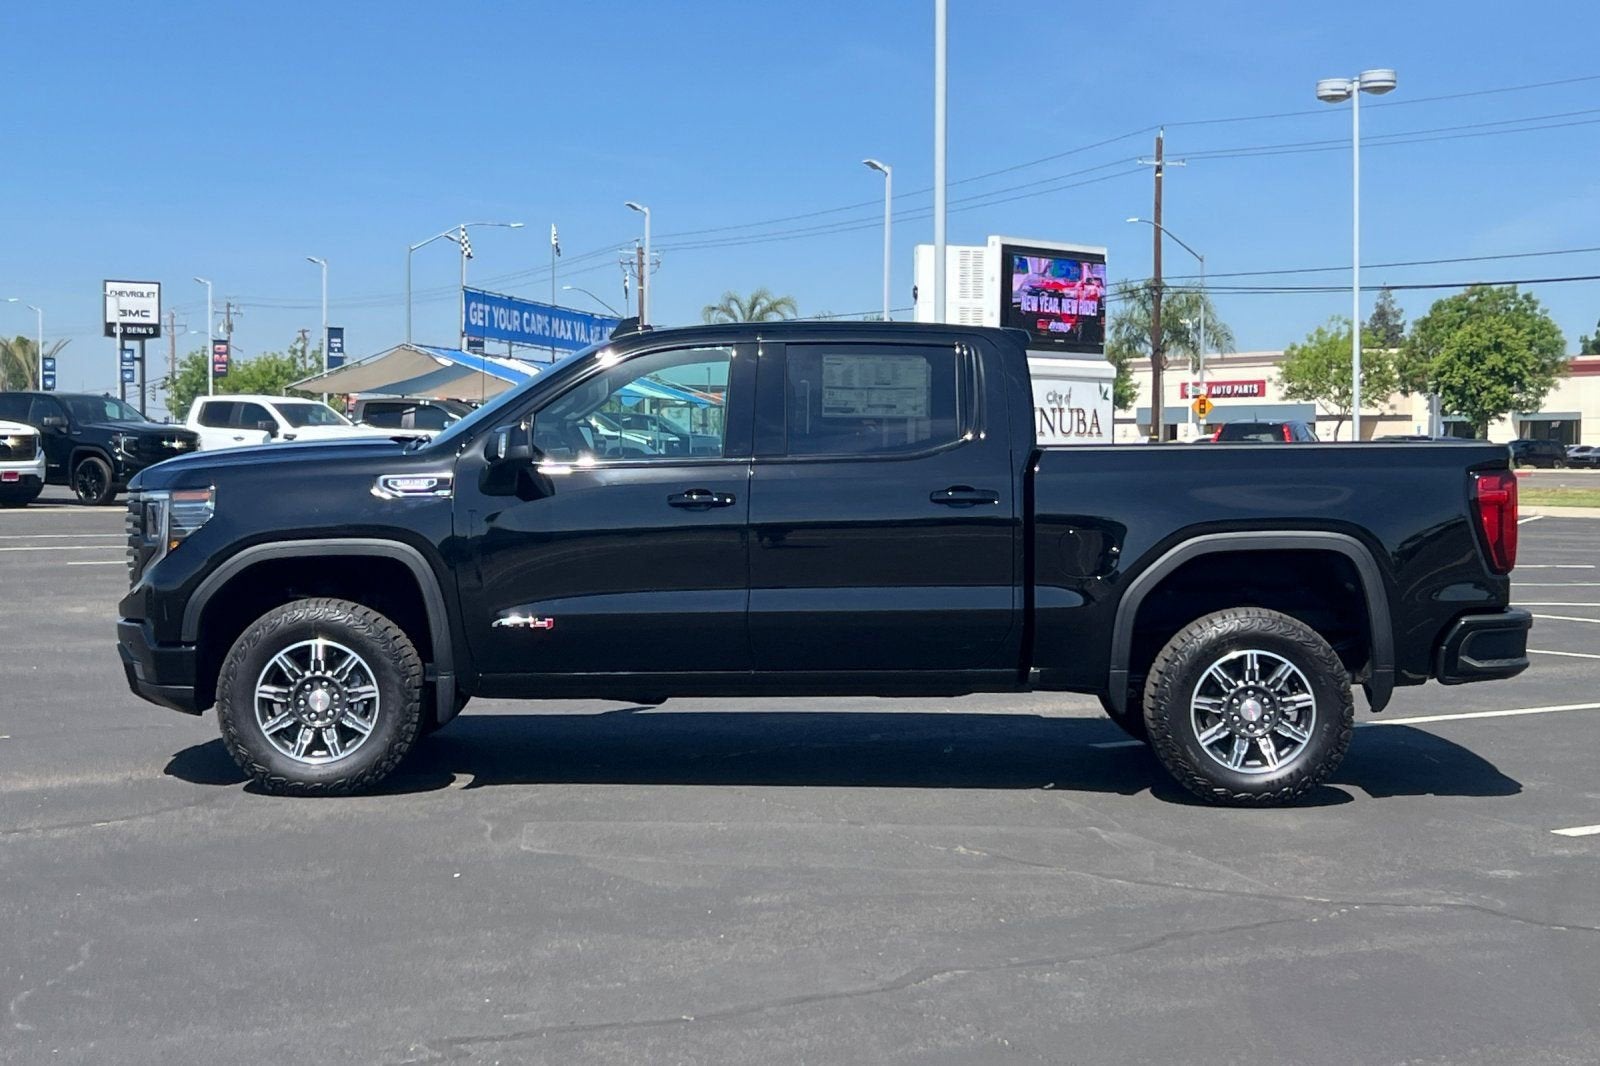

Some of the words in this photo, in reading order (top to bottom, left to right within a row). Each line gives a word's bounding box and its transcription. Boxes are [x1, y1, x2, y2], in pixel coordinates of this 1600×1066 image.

[109, 290, 156, 298] CHEVROLET
[1020, 294, 1039, 312] NEW
[1061, 298, 1079, 315] NEW
[118, 309, 151, 318] GMC
[469, 301, 490, 327] GET
[492, 305, 521, 332] YOUR
[523, 311, 550, 337] CAR'S
[551, 316, 573, 342] MAX
[1211, 384, 1232, 395] AUTO
[1233, 383, 1259, 395] PARTS
[1036, 407, 1103, 437] NUBA
